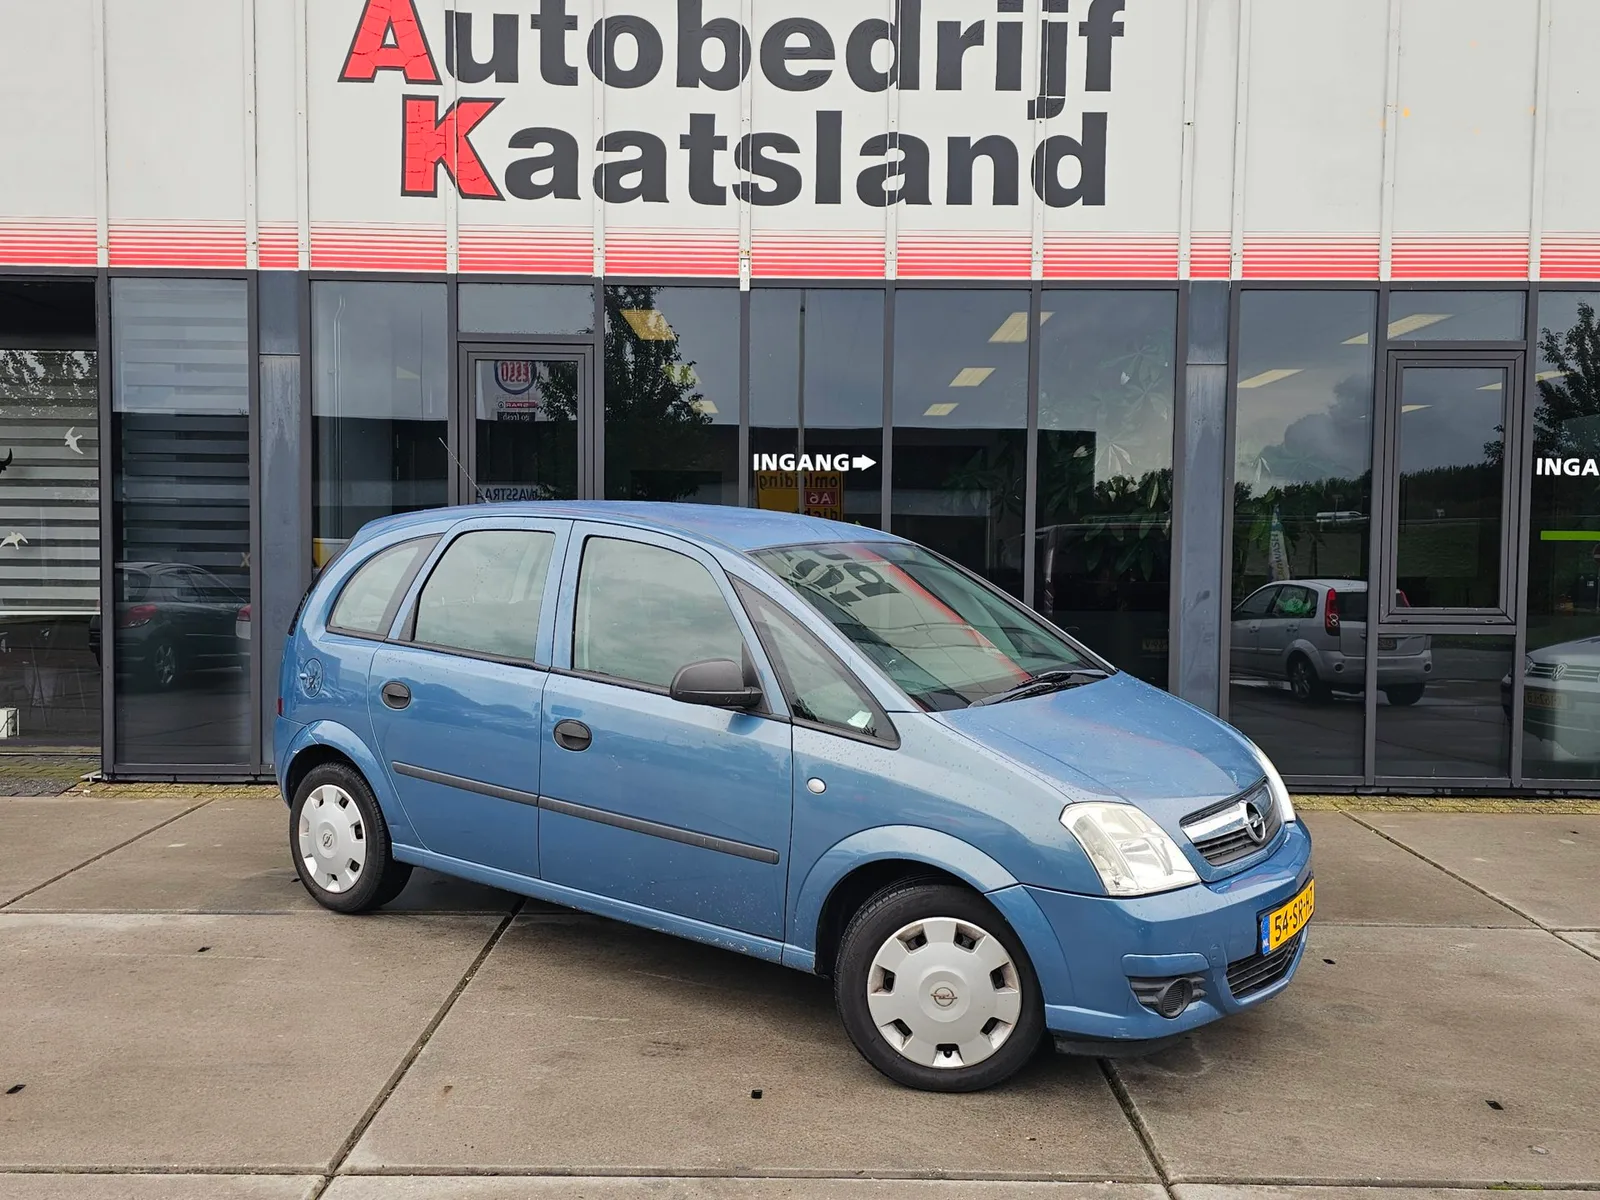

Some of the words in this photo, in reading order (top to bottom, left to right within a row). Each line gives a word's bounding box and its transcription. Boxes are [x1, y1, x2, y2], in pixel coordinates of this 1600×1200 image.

[338, 0, 1125, 120] Autobedrijf
[401, 94, 1108, 208] Kaatsland
[753, 453, 850, 471] INGANG
[1536, 457, 1600, 476] INGA
